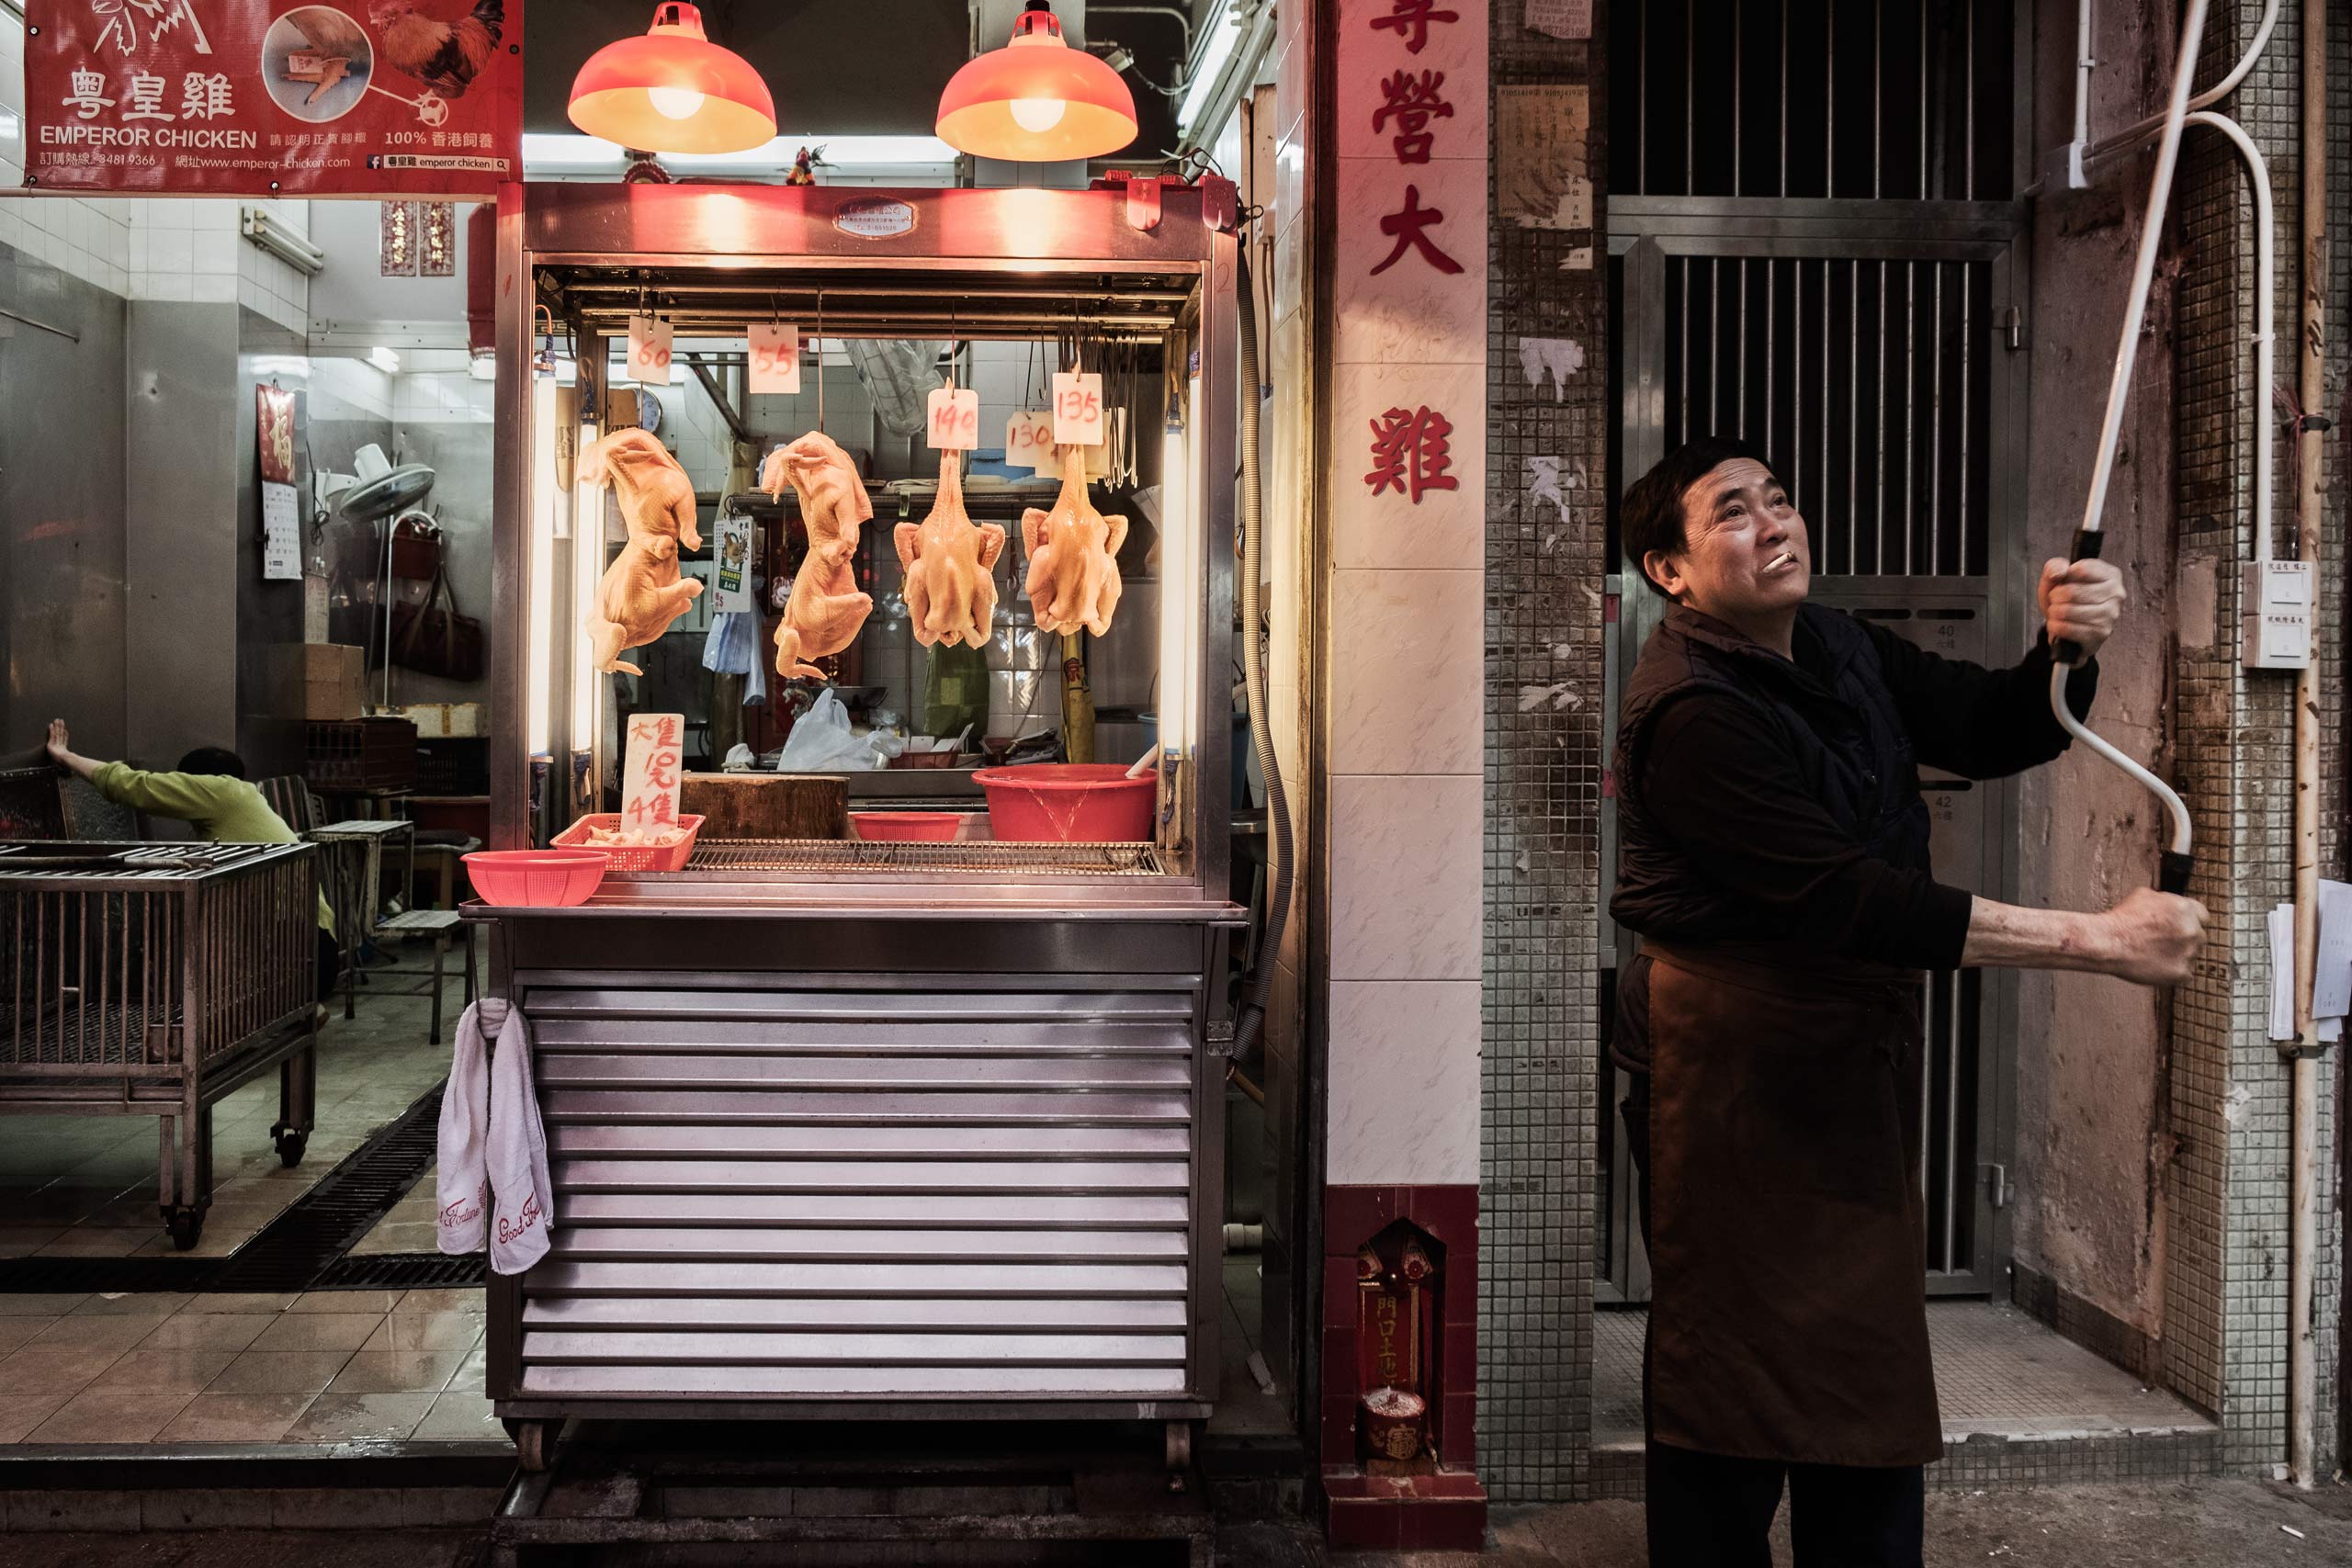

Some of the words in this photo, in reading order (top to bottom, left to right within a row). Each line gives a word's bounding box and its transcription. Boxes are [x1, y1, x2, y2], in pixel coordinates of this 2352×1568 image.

[40, 126, 151, 147] EMPEROR
[155, 129, 257, 149] CHICKEN
[385, 132, 426, 145] 100%
[432, 131, 493, 148] 香港飼養
[99, 154, 125, 164] 3481
[129, 155, 155, 166] 9366
[419, 158, 456, 169] emperor
[458, 158, 490, 169] chicken
[1216, 262, 1231, 294] 2
[638, 339, 670, 367] 60
[755, 343, 795, 375] 55
[1057, 390, 1099, 423] 135
[934, 404, 975, 435] 140
[1011, 423, 1050, 448] 130
[1938, 626, 1955, 637] 40
[1935, 796, 1951, 807] 42
[499, 1216, 525, 1244] Good
